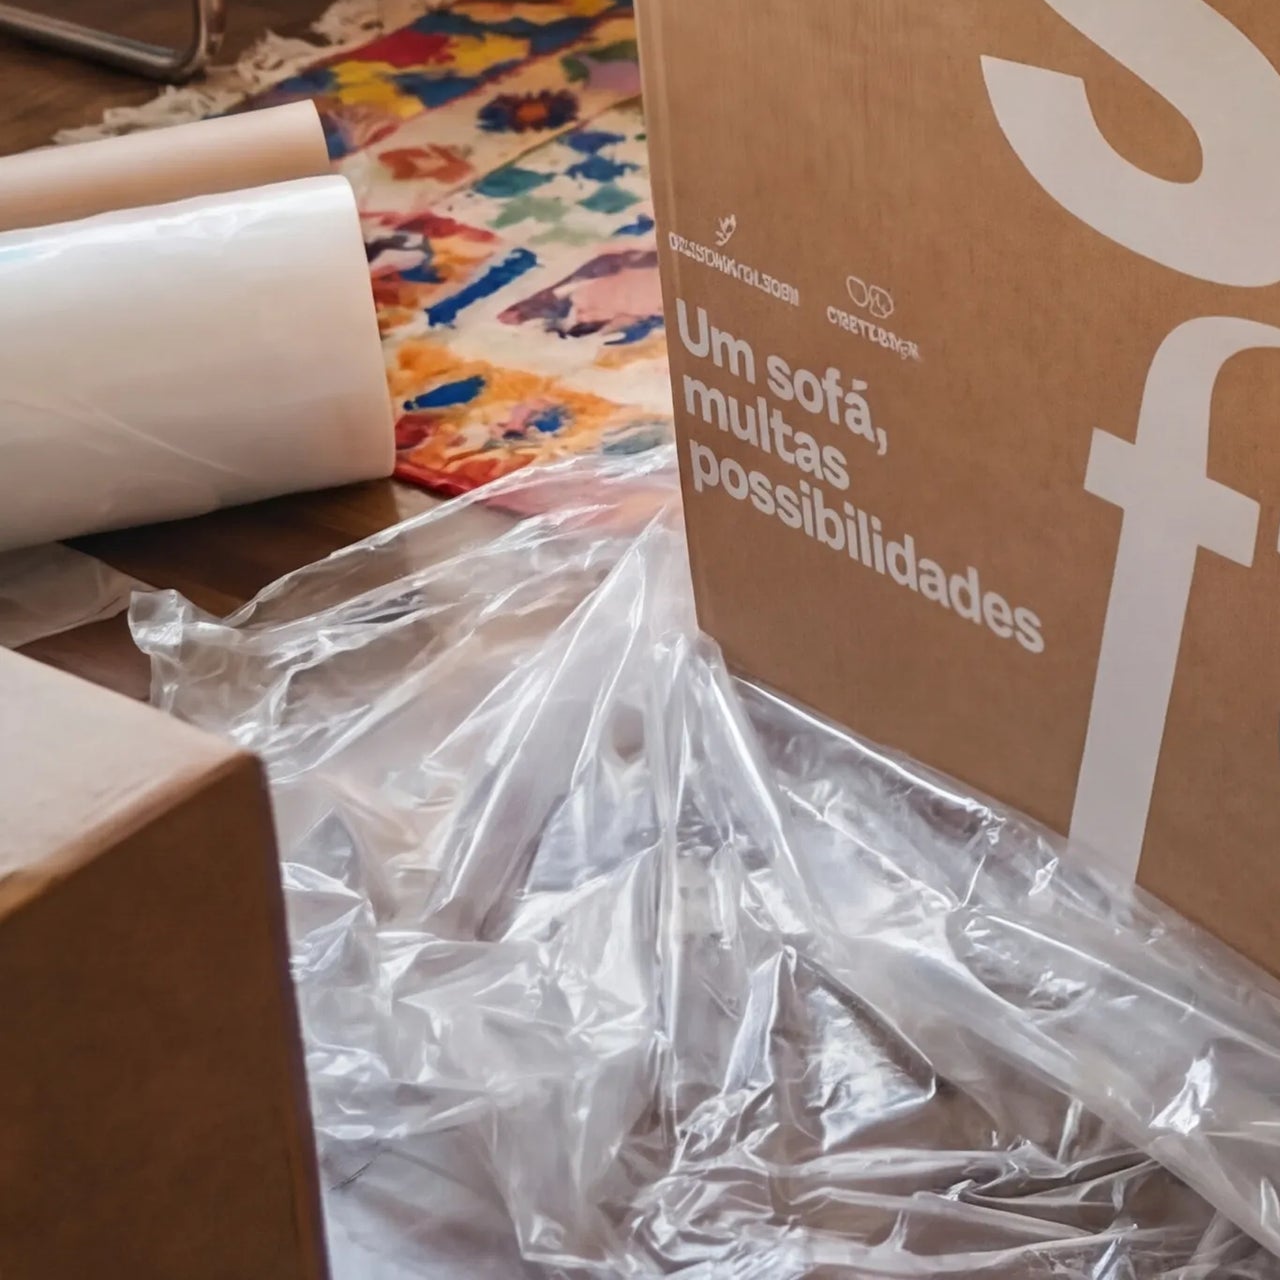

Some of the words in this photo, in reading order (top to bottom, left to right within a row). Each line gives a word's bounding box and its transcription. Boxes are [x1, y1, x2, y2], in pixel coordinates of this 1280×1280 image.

[676, 297, 756, 385] Um
[766, 353, 888, 456] sofá,
[689, 438, 1045, 654] possibilidades
